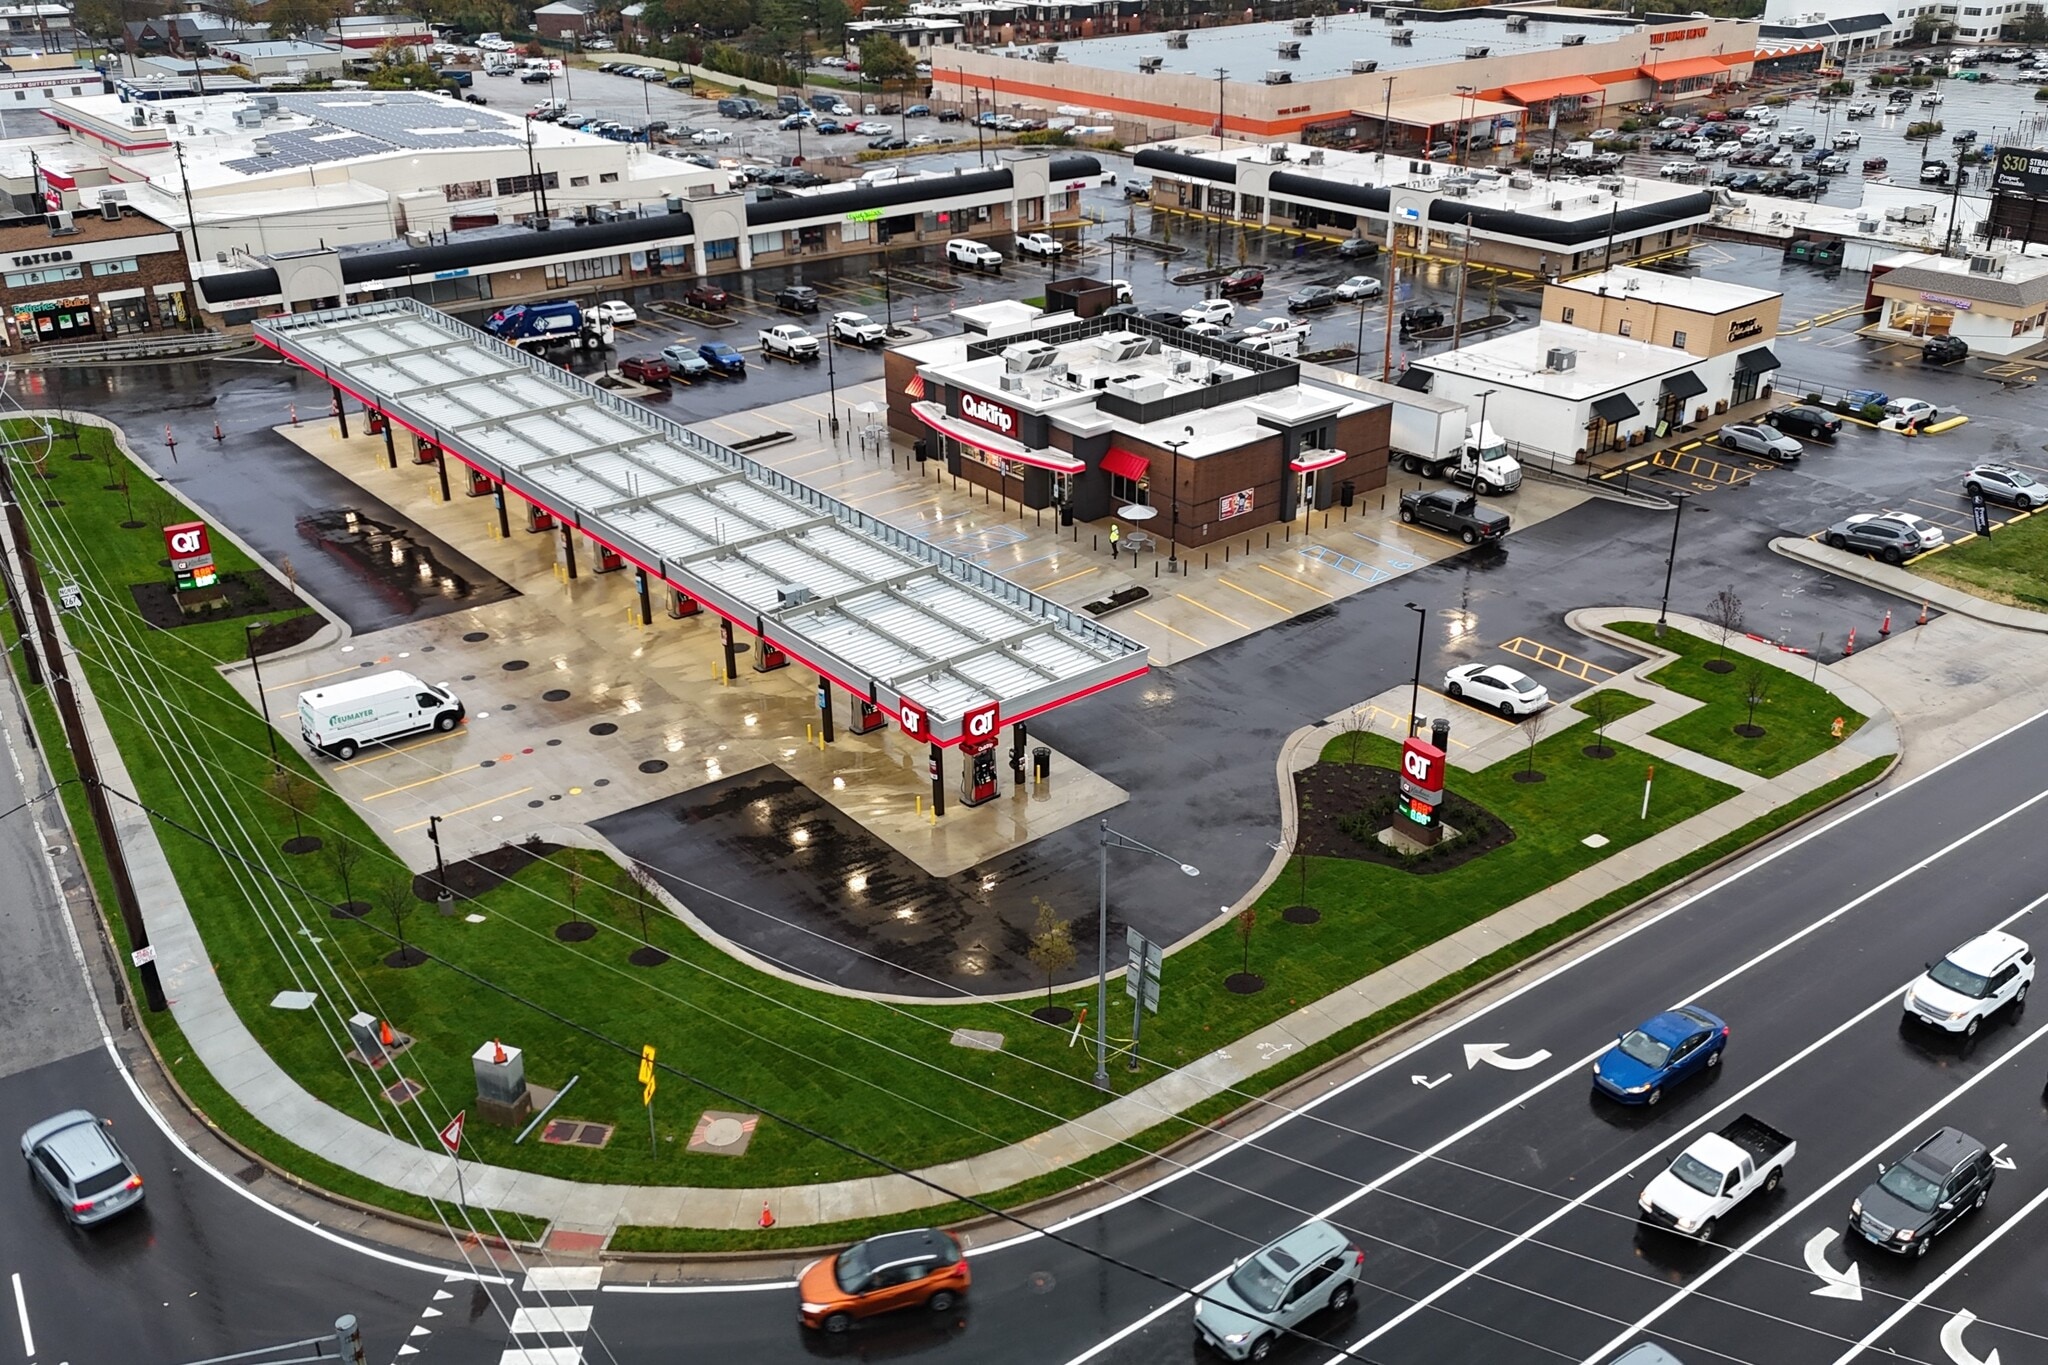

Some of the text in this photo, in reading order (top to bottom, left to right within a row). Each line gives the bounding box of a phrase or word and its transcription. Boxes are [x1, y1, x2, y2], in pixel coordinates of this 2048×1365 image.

[1650, 26, 1708, 45] THE HOME DEPOT
[27, 80, 56, 88] GUTTERS
[2002, 154, 2028, 171] $30
[2028, 165, 2042, 175] THE
[12, 250, 73, 267] TATTOO
[13, 301, 56, 315] Batteries
[62, 297, 90, 308] Bulbs
[962, 394, 1012, 432] QuikTrip
[171, 530, 201, 553] QT
[64, 596, 77, 607] 267
[901, 706, 920, 733] QT
[969, 709, 996, 736] QT
[1404, 750, 1431, 780] QT
